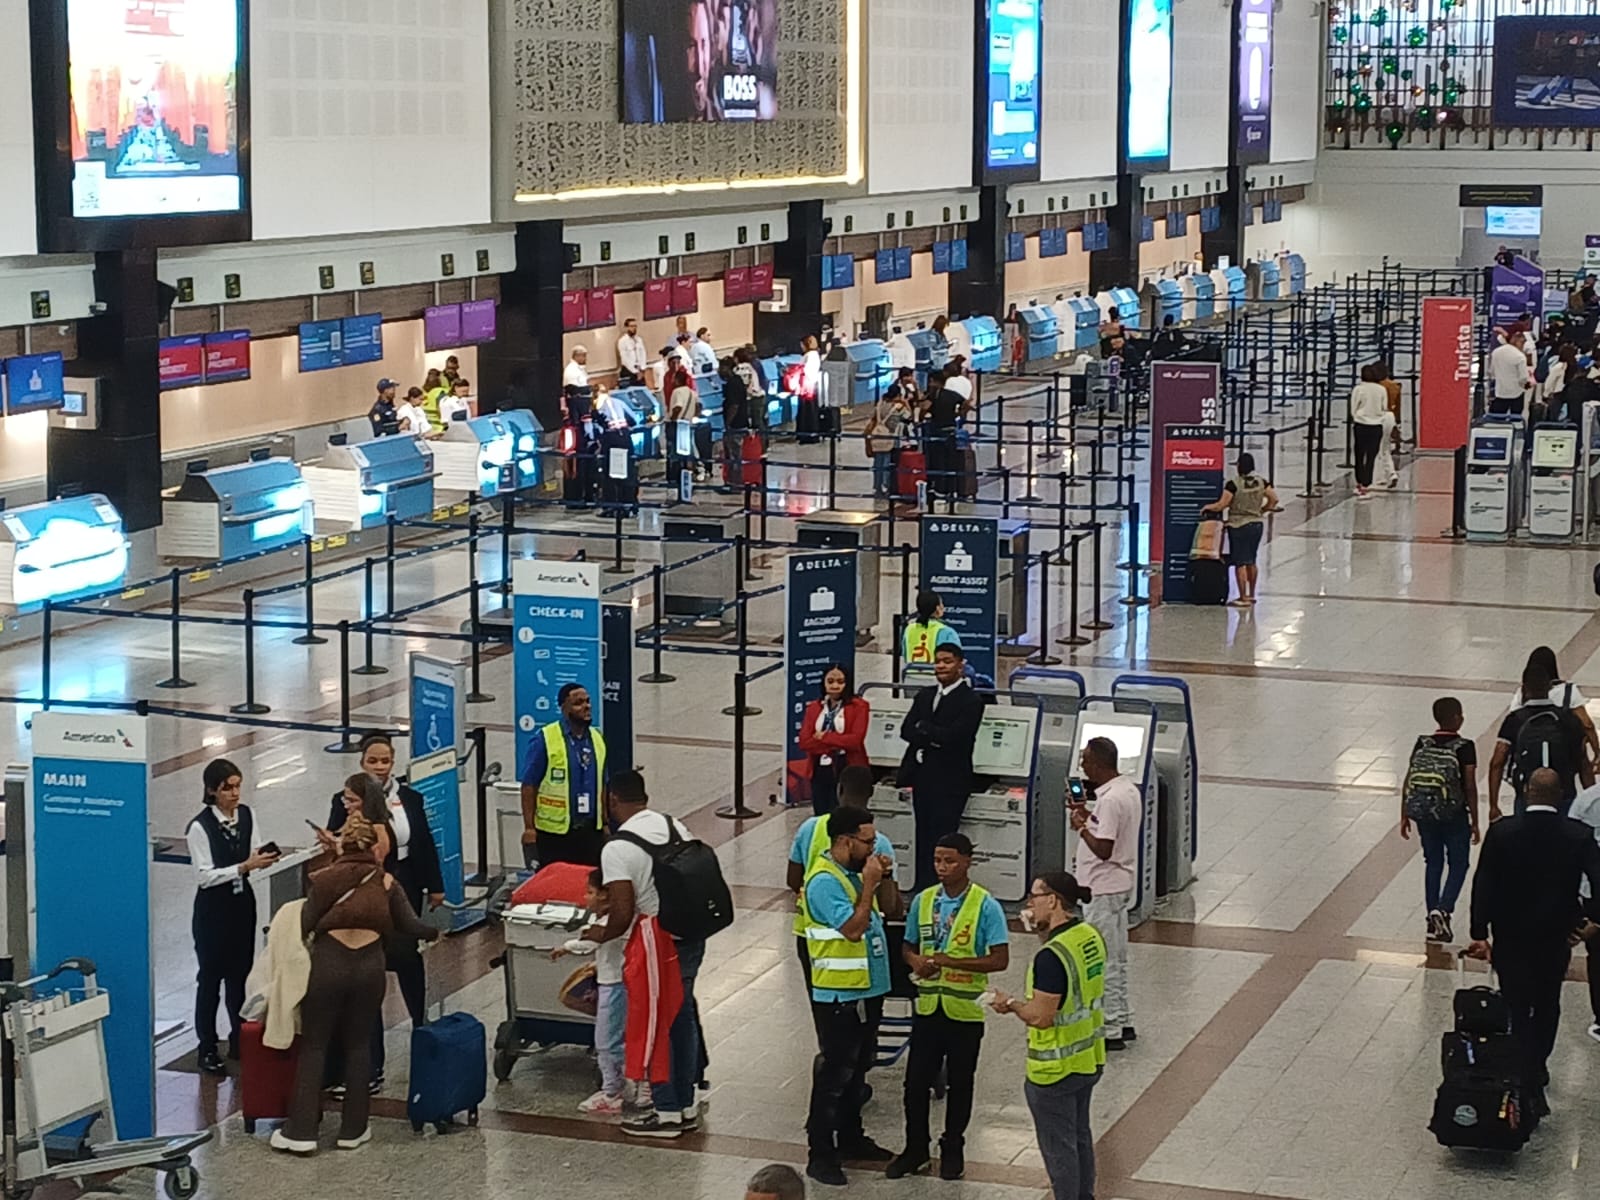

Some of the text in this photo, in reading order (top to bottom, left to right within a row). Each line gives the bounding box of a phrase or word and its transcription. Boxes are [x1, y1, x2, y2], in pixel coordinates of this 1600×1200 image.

[724, 75, 757, 101] BOSS
[1455, 325, 1471, 381] Turista
[1181, 428, 1211, 436] DELTA
[941, 523, 980, 533] DELTA
[806, 559, 841, 570] DELTA
[537, 573, 577, 584] American
[529, 606, 584, 620] CHECK-IN
[63, 730, 116, 744] American
[43, 773, 87, 788] MAIN
